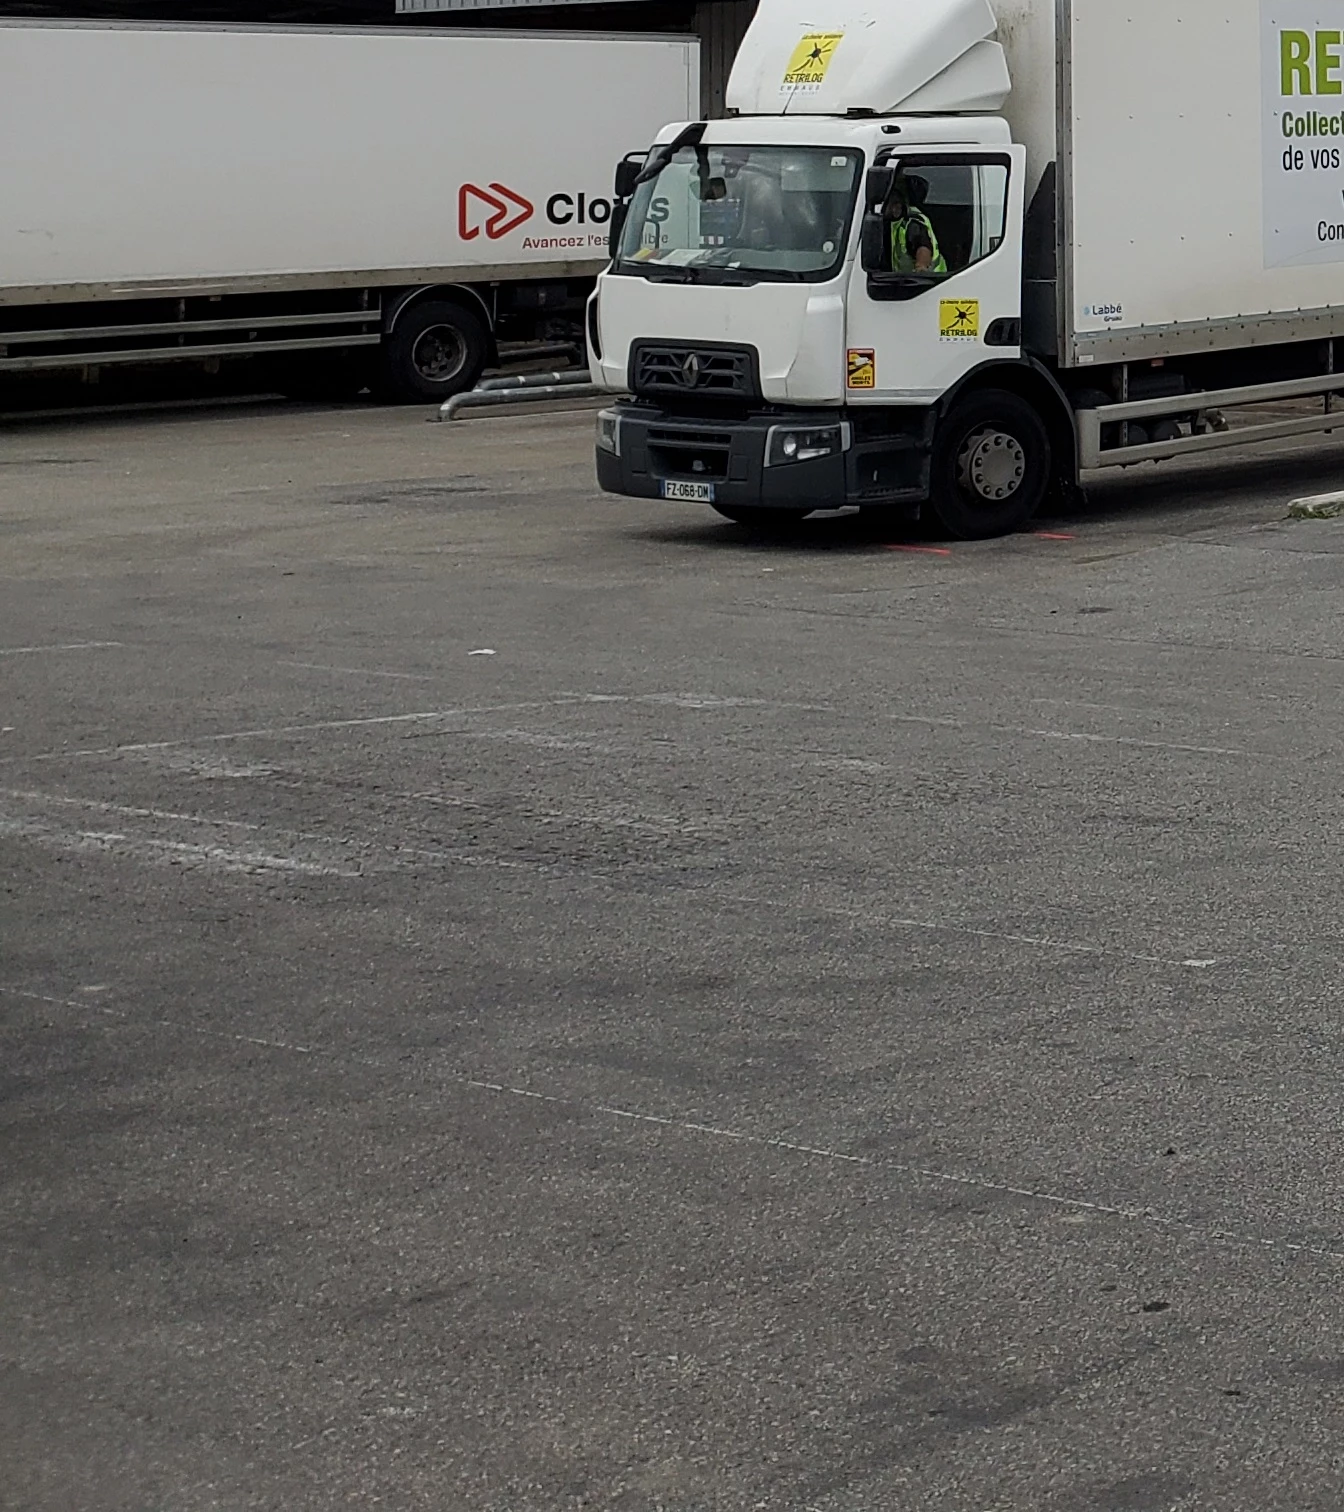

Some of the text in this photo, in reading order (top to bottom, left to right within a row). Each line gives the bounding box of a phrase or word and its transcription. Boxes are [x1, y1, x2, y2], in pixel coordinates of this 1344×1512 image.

[1282, 144, 1304, 171] de
[1310, 147, 1340, 169] vos
[546, 192, 669, 225] Clos
[522, 236, 585, 249] Avancez
